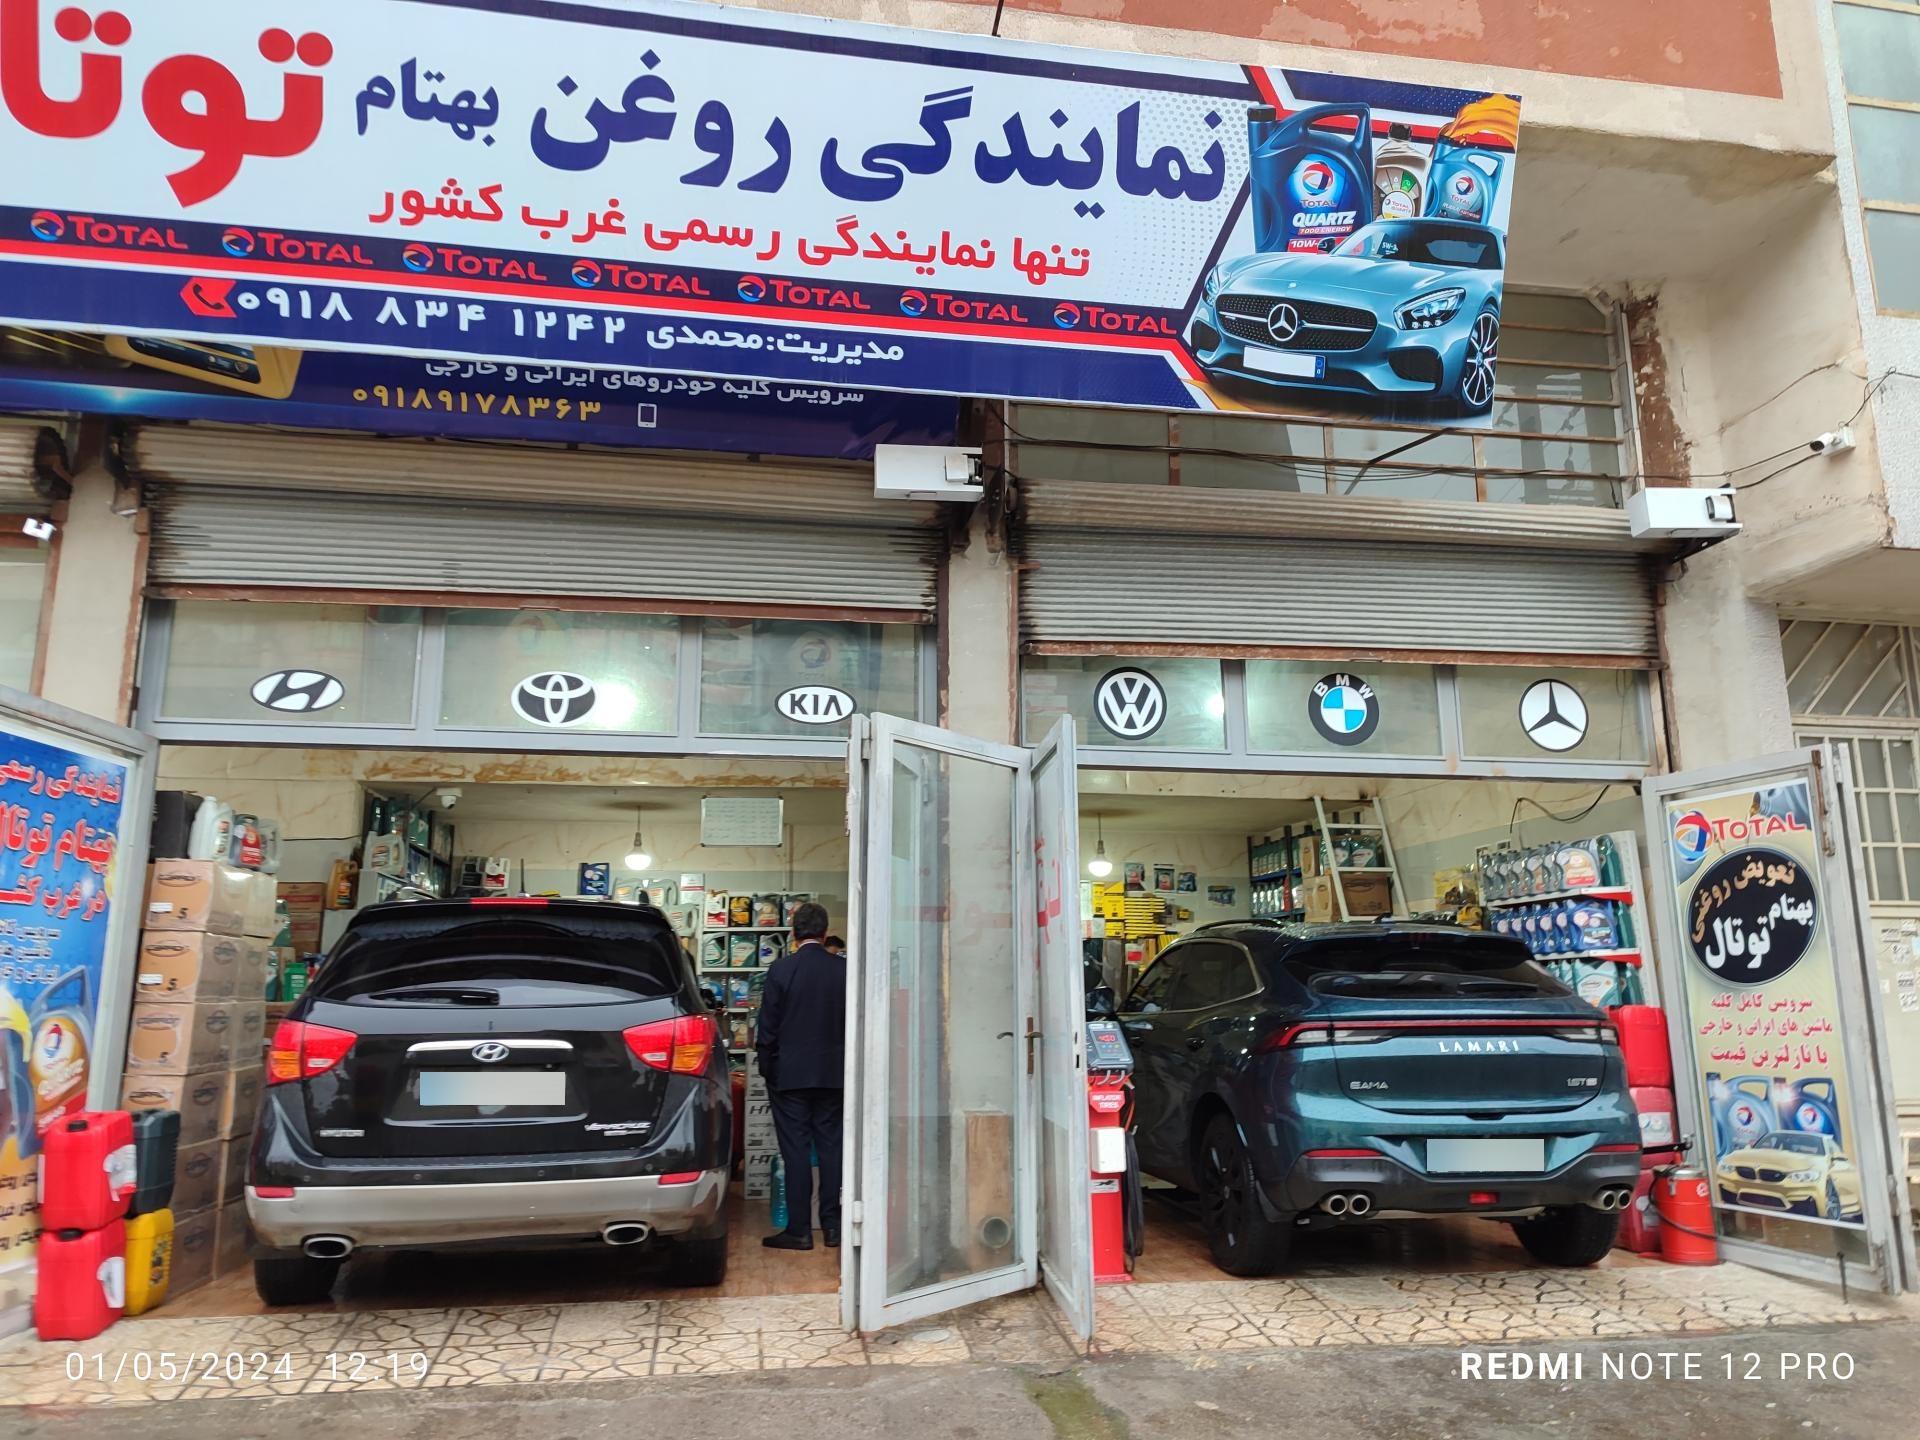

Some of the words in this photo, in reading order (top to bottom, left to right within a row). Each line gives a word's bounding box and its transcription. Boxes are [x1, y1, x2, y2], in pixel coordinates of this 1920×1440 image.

[355, 57, 500, 147] بهتام
[530, 48, 793, 193] روغن
[820, 85, 1226, 220] نمایندگی
[369, 178, 504, 224] کشور
[520, 197, 627, 243] غرب
[1292, 211, 1357, 227] QUARTZ
[643, 217, 782, 260] رسمی
[797, 214, 996, 277] نمایندگی
[67, 215, 189, 251] TOTAL
[258, 231, 374, 266] TOTAL
[443, 247, 548, 282] TOTAL
[604, 262, 710, 297] TOTAL
[768, 278, 871, 311] TOTAL
[929, 293, 1029, 323] TOTAL
[1082, 306, 1177, 336] TOTAL
[1013, 237, 1091, 286] تنها
[237, 287, 353, 322] ۰۹۱۸
[376, 297, 486, 332] ۸۳۴
[513, 308, 626, 344] ۱۲۴۲
[504, 366, 519, 382] و
[722, 379, 771, 399] کلیه
[352, 385, 601, 421] ۰۹۱۸۹۱۷۸۳۶۳
[776, 386, 864, 405] سرویس
[1313, 673, 1375, 700] BMW
[790, 693, 841, 717] KIA
[46, 765, 122, 806] نمایندگی
[1712, 812, 1806, 841] TOTAL
[53, 818, 117, 876] بهتام
[1734, 855, 1796, 889] تعویض
[42, 881, 82, 920] غرب
[81, 889, 107, 921] در
[1768, 893, 1813, 931] بهتام
[1705, 916, 1771, 969] توتال
[1711, 993, 1732, 1010] کلیه
[1737, 992, 1763, 1012] کامل
[1769, 998, 1812, 1013] سرویس
[1700, 1017, 1733, 1035] خارجی
[1745, 1017, 1775, 1036] ایرانی
[1779, 1017, 1798, 1035] های
[1803, 1016, 1833, 1036] ماشین
[1438, 1040, 1520, 1053] LAMARI
[1711, 1041, 1746, 1065] قیمت
[1816, 1045, 1828, 1069] با
